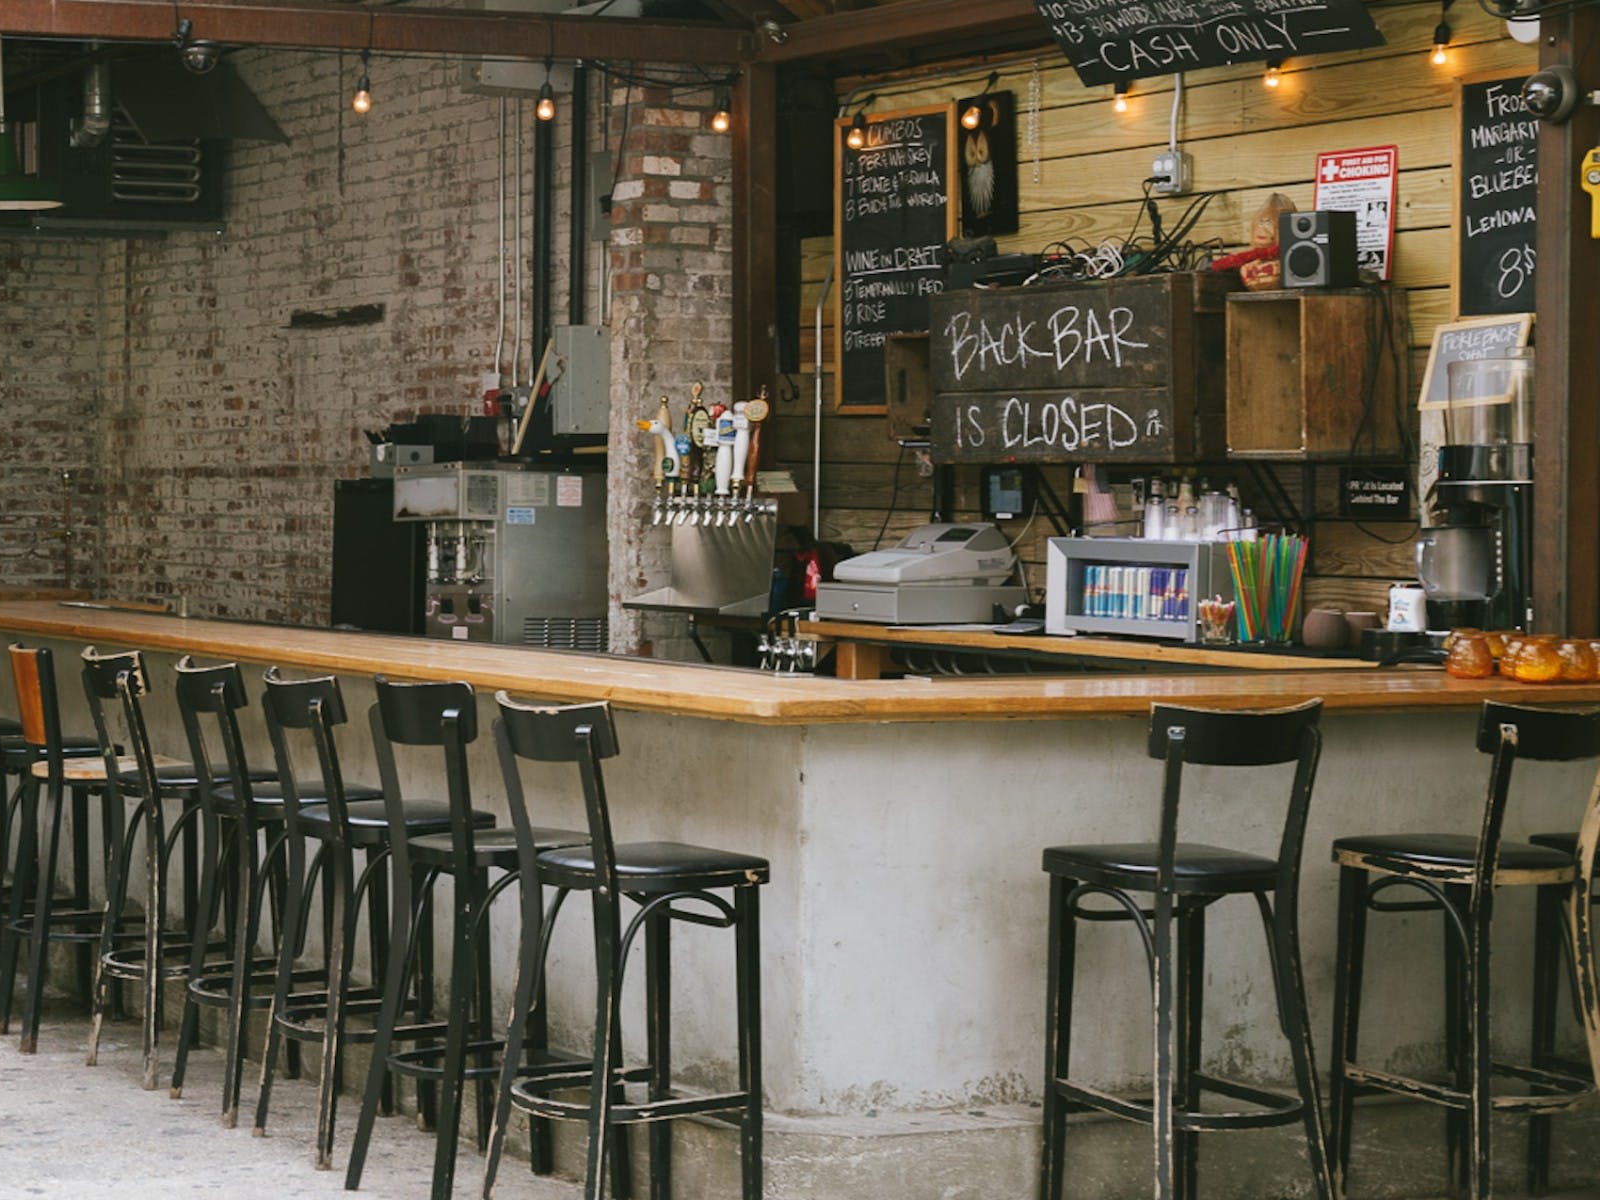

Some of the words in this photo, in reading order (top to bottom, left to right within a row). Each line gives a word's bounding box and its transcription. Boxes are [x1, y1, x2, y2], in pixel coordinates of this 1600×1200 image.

[1100, 32, 1200, 71] CASH
[1217, 13, 1297, 54] ONLY
[1486, 85, 1529, 117] FROZ
[1471, 120, 1539, 149] MARGARIT
[1339, 163, 1390, 178] CHOKING
[846, 199, 855, 220] 8
[1467, 207, 1536, 237] LEMONA
[845, 249, 880, 272] WINE
[894, 245, 942, 268] DRAFT
[918, 277, 944, 296] RED
[944, 311, 1053, 380] BACK
[1047, 306, 1149, 370] BAR
[956, 406, 985, 448] IS
[1003, 397, 1137, 451] CLOSED
[1386, 494, 1400, 504] Bar
